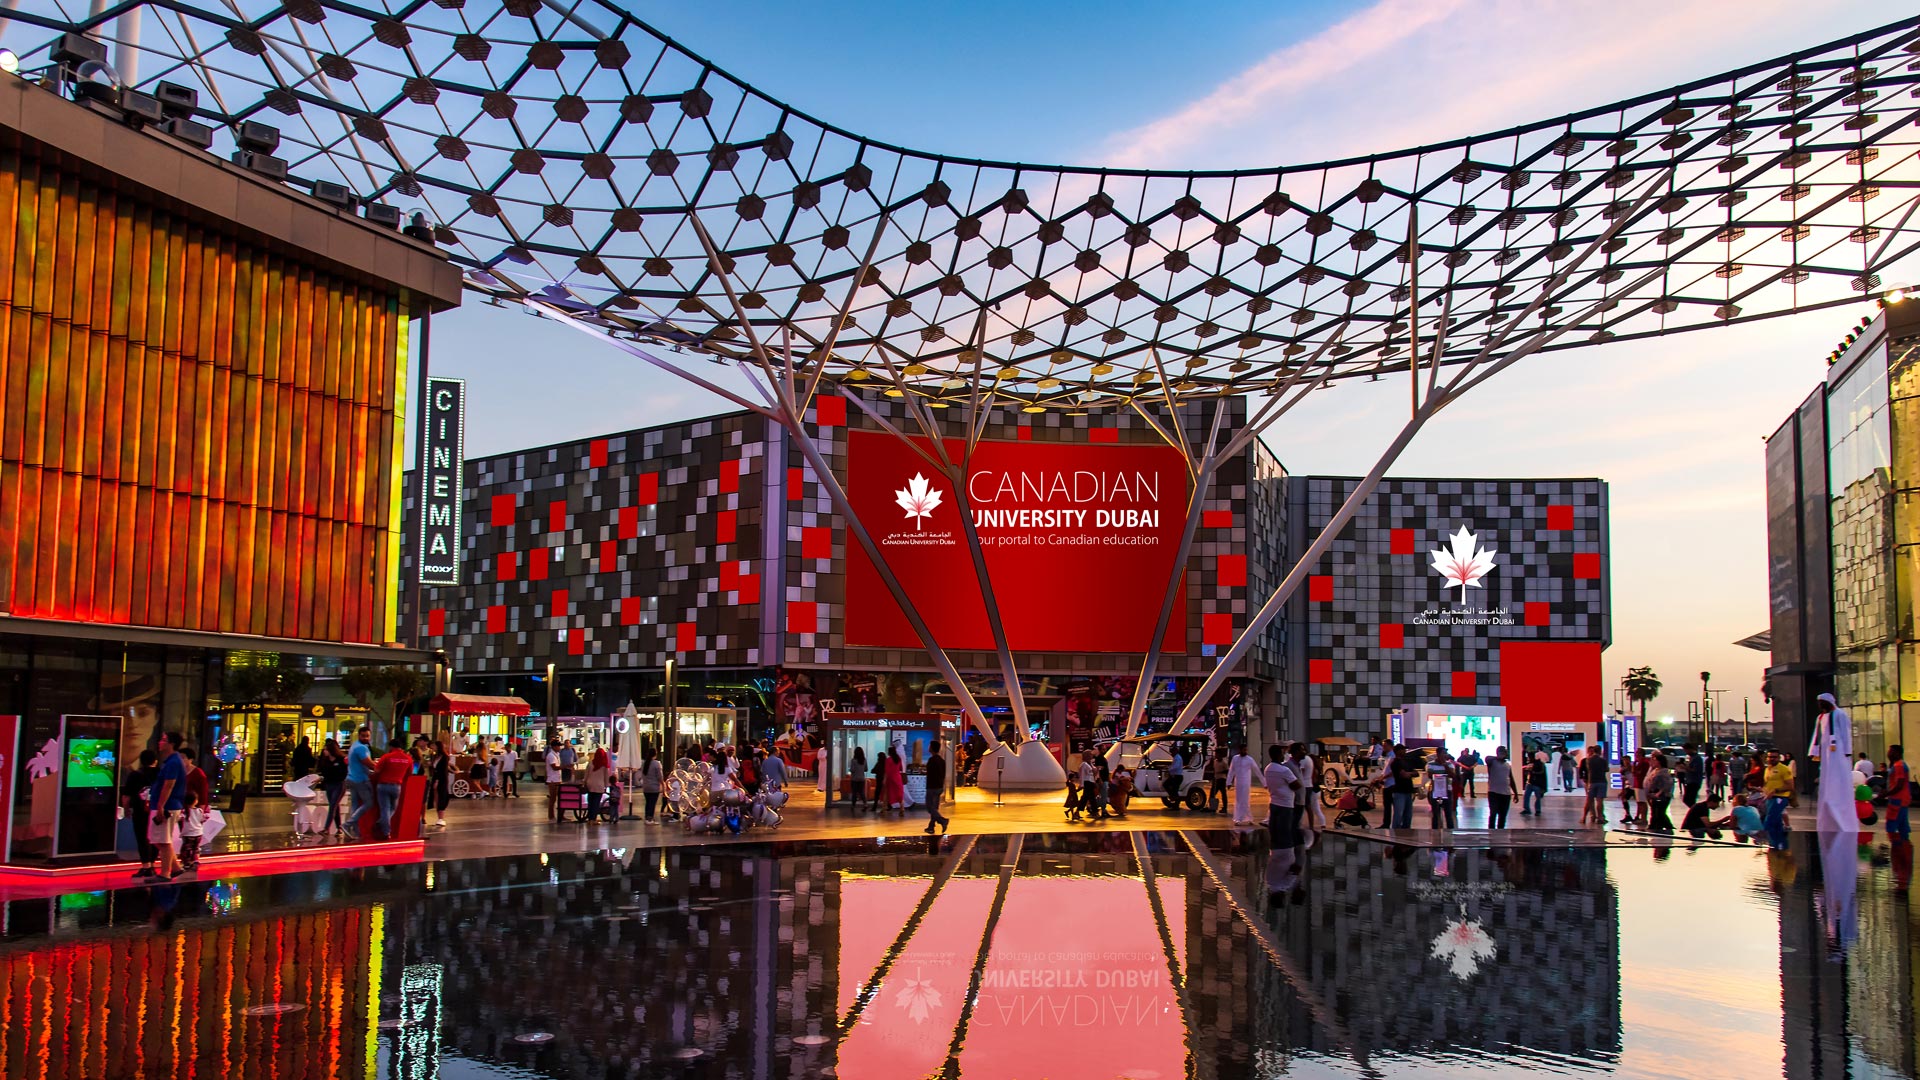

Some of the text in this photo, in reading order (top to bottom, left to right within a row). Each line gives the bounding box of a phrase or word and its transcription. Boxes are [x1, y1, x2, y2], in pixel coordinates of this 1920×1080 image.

[429, 388, 453, 555] CINEMA
[969, 470, 1158, 503] CANADIAN
[970, 509, 1159, 528] UNIVERSITY DUBAI
[977, 533, 1159, 547] our portal to Canadian education
[424, 565, 454, 573] ROXY
[1420, 608, 1438, 618] دبي
[1478, 607, 1508, 617] الجامعة
